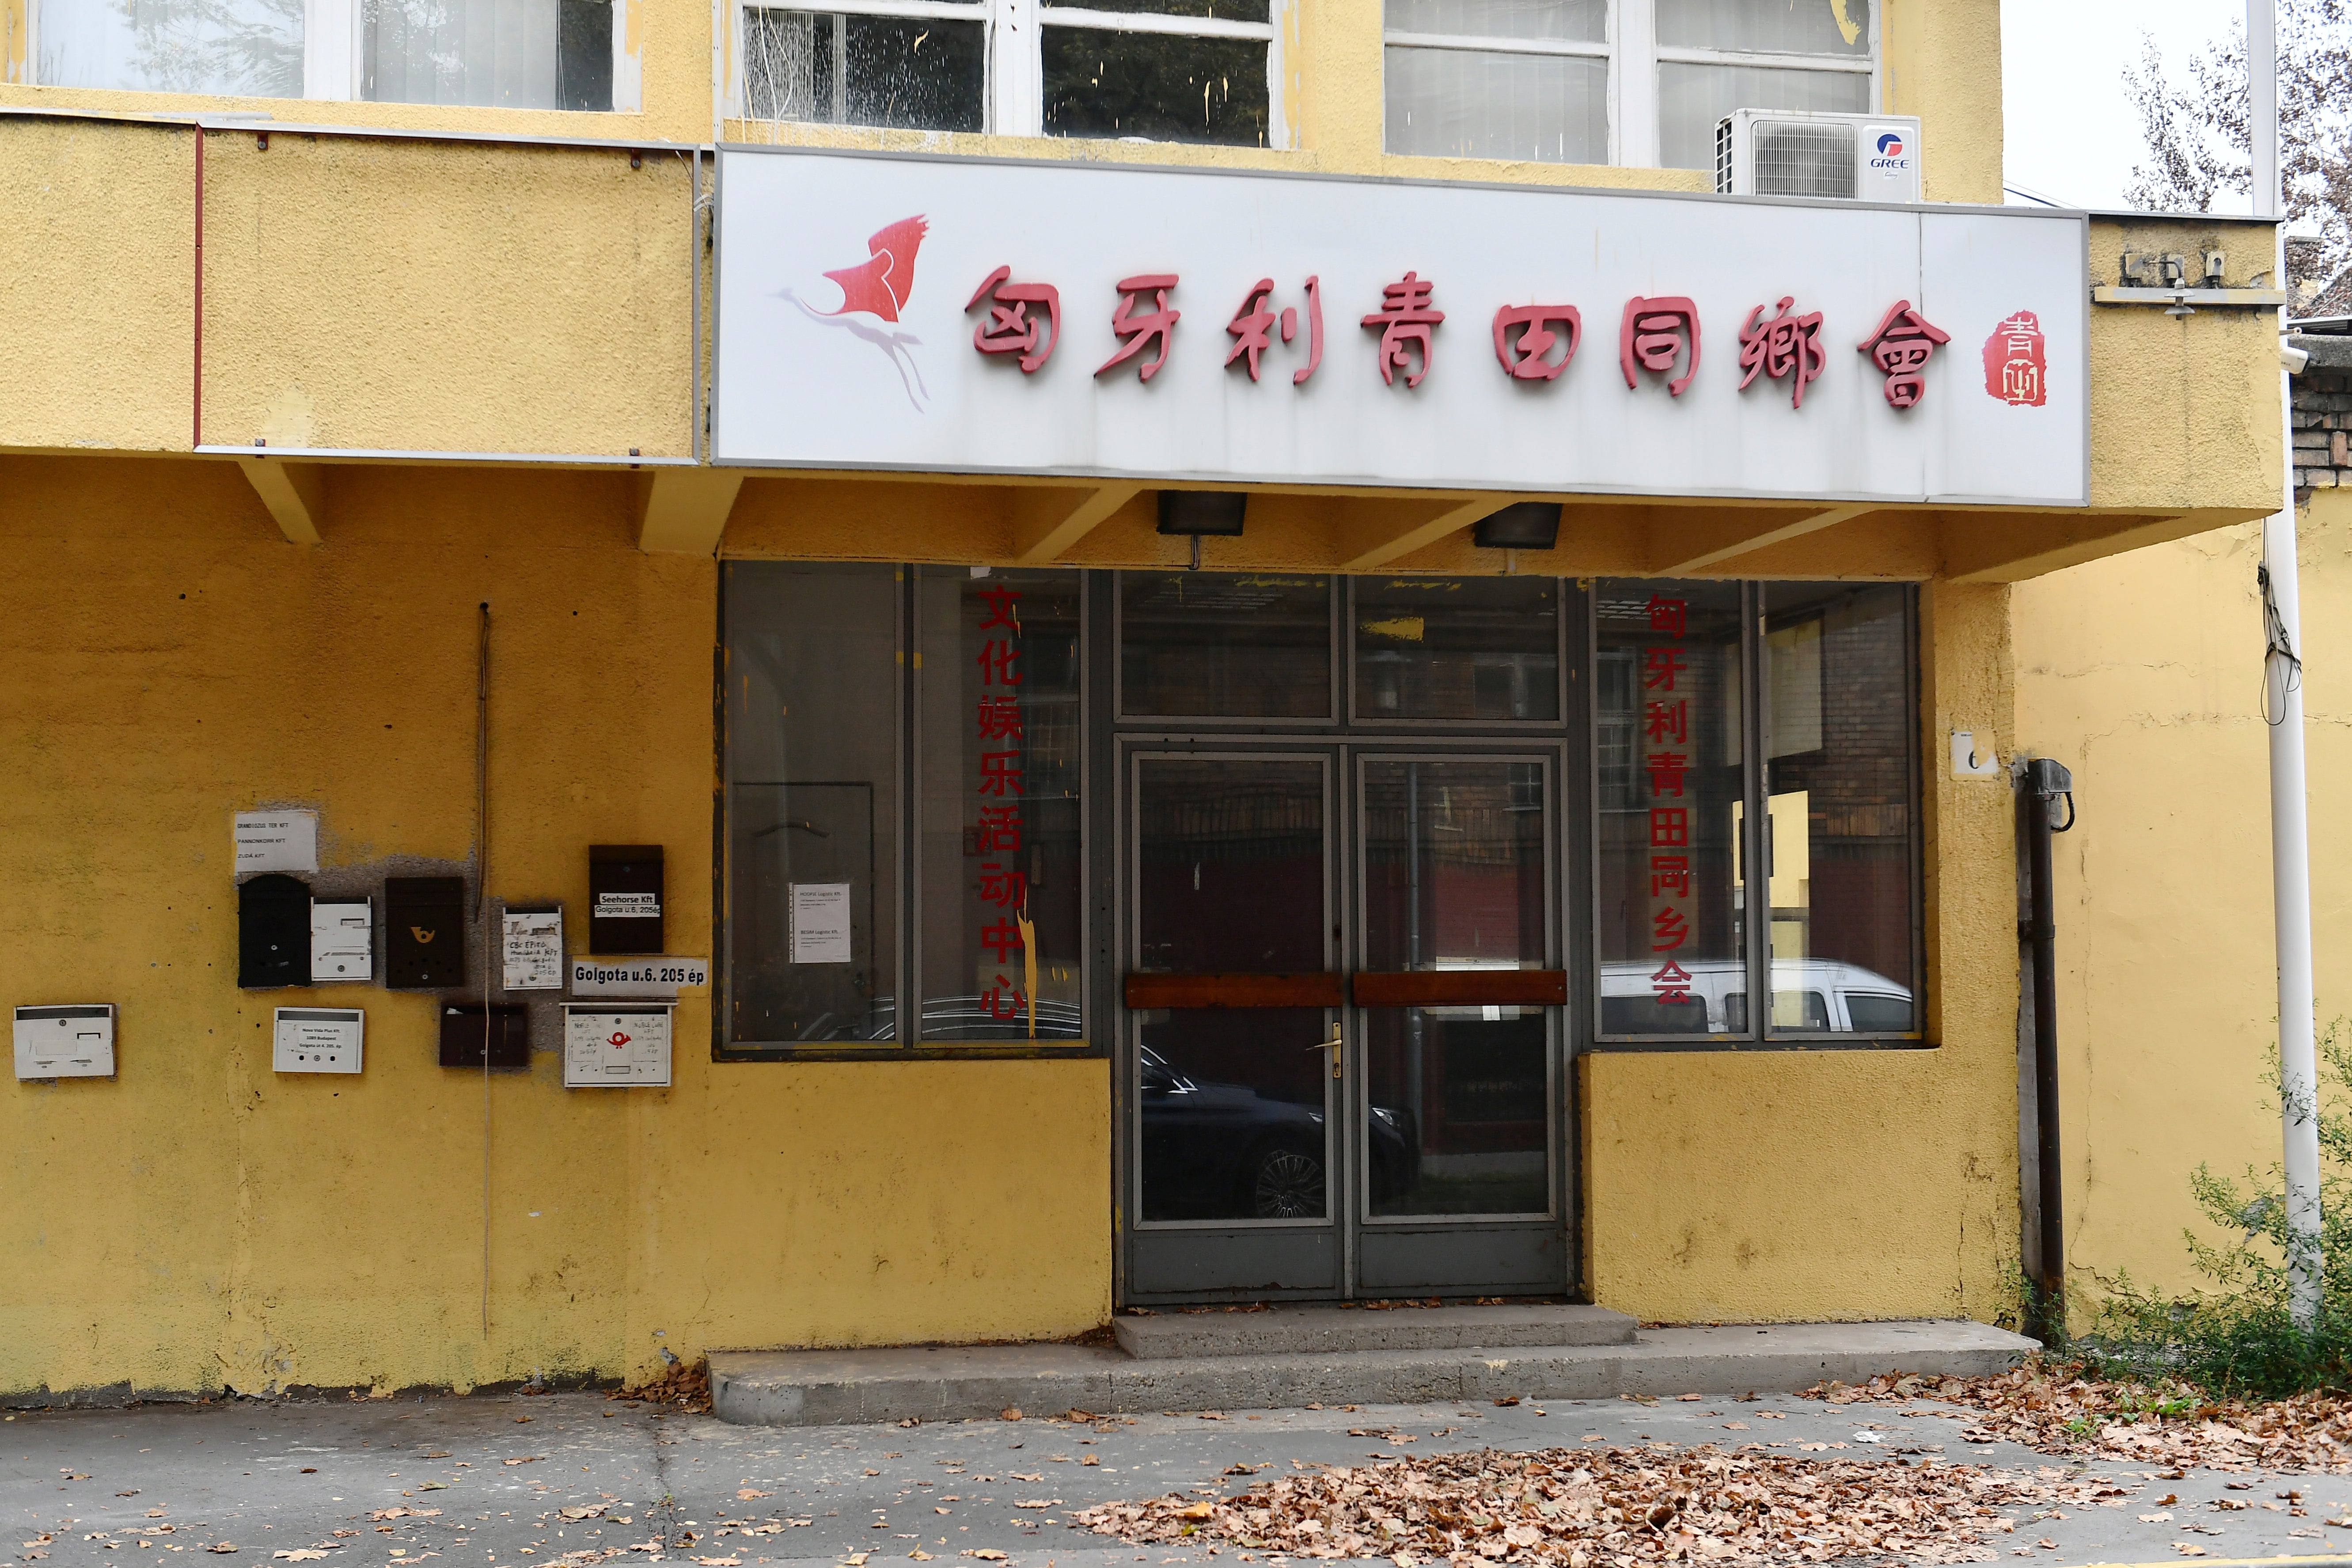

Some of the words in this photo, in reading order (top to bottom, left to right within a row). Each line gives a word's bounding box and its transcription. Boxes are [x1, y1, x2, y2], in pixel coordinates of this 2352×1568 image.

[1870, 158, 1909, 169] GREE
[965, 265, 1952, 410] 匈牙利青田同鄉會
[977, 585, 1025, 1020] 文化娱乐活动中心
[1646, 593, 1692, 1005] 匈牙利青田同乡会
[596, 906, 623, 914] Golgota
[576, 966, 628, 984] Golgota
[632, 968, 656, 982] u.6.
[660, 968, 684, 982] 205
[688, 968, 704, 986] ép
